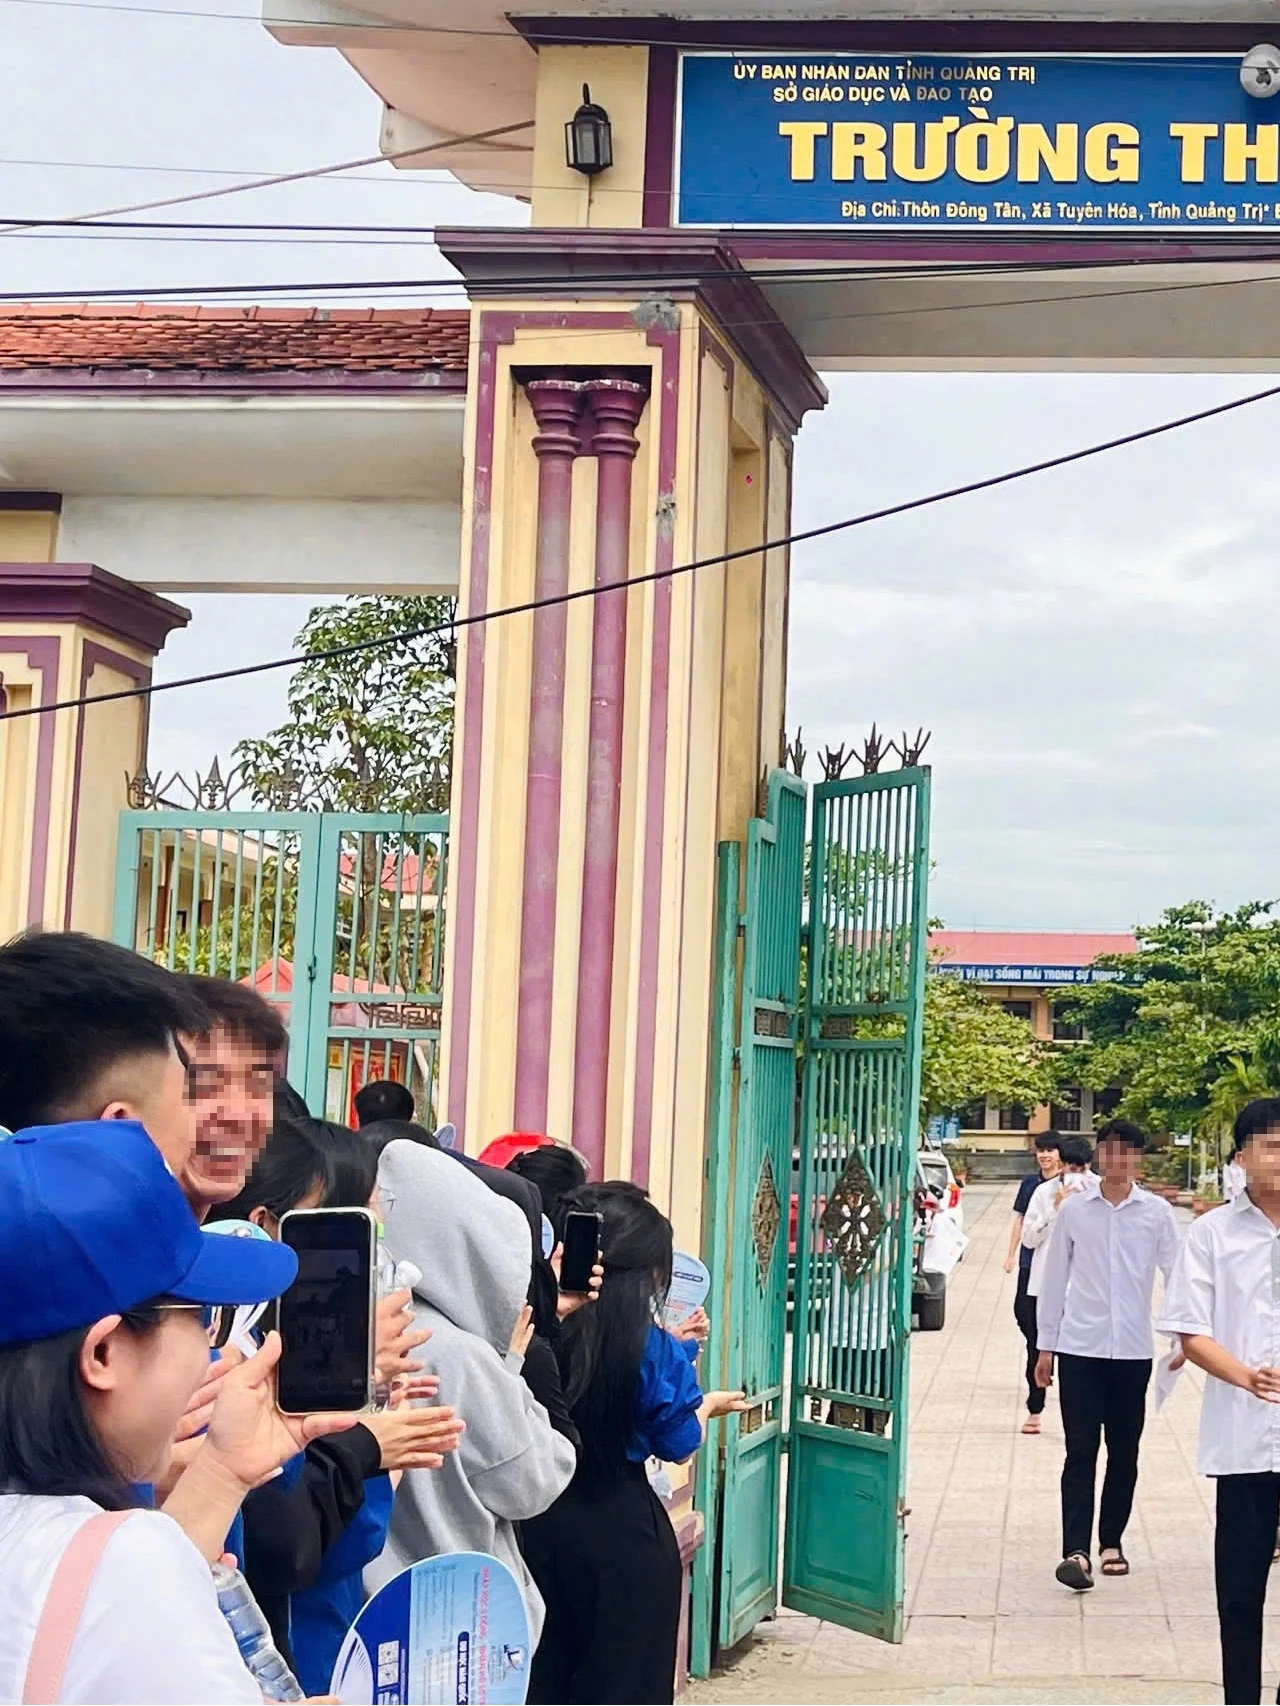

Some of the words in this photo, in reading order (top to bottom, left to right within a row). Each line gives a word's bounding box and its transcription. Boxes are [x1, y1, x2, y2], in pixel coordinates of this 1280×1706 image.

[734, 60, 755, 80] ỦY
[761, 65, 797, 80] BAN
[895, 60, 934, 80] TỈNH
[1007, 66, 1035, 85] TRỊ
[773, 81, 798, 102] SỞ
[848, 86, 885, 106] DỤC
[889, 83, 911, 102] VÀ
[958, 85, 993, 105] TẠO
[779, 107, 1140, 183] TRƯỜNG
[841, 201, 866, 220] Địa
[1031, 202, 1052, 218] Xã
[1057, 202, 1103, 223] Tuyên
[1107, 202, 1144, 221] Hóa,
[1149, 200, 1181, 219] Tỉnh
[1185, 201, 1237, 223] Quảng
[1043, 969, 1074, 980] TRONG
